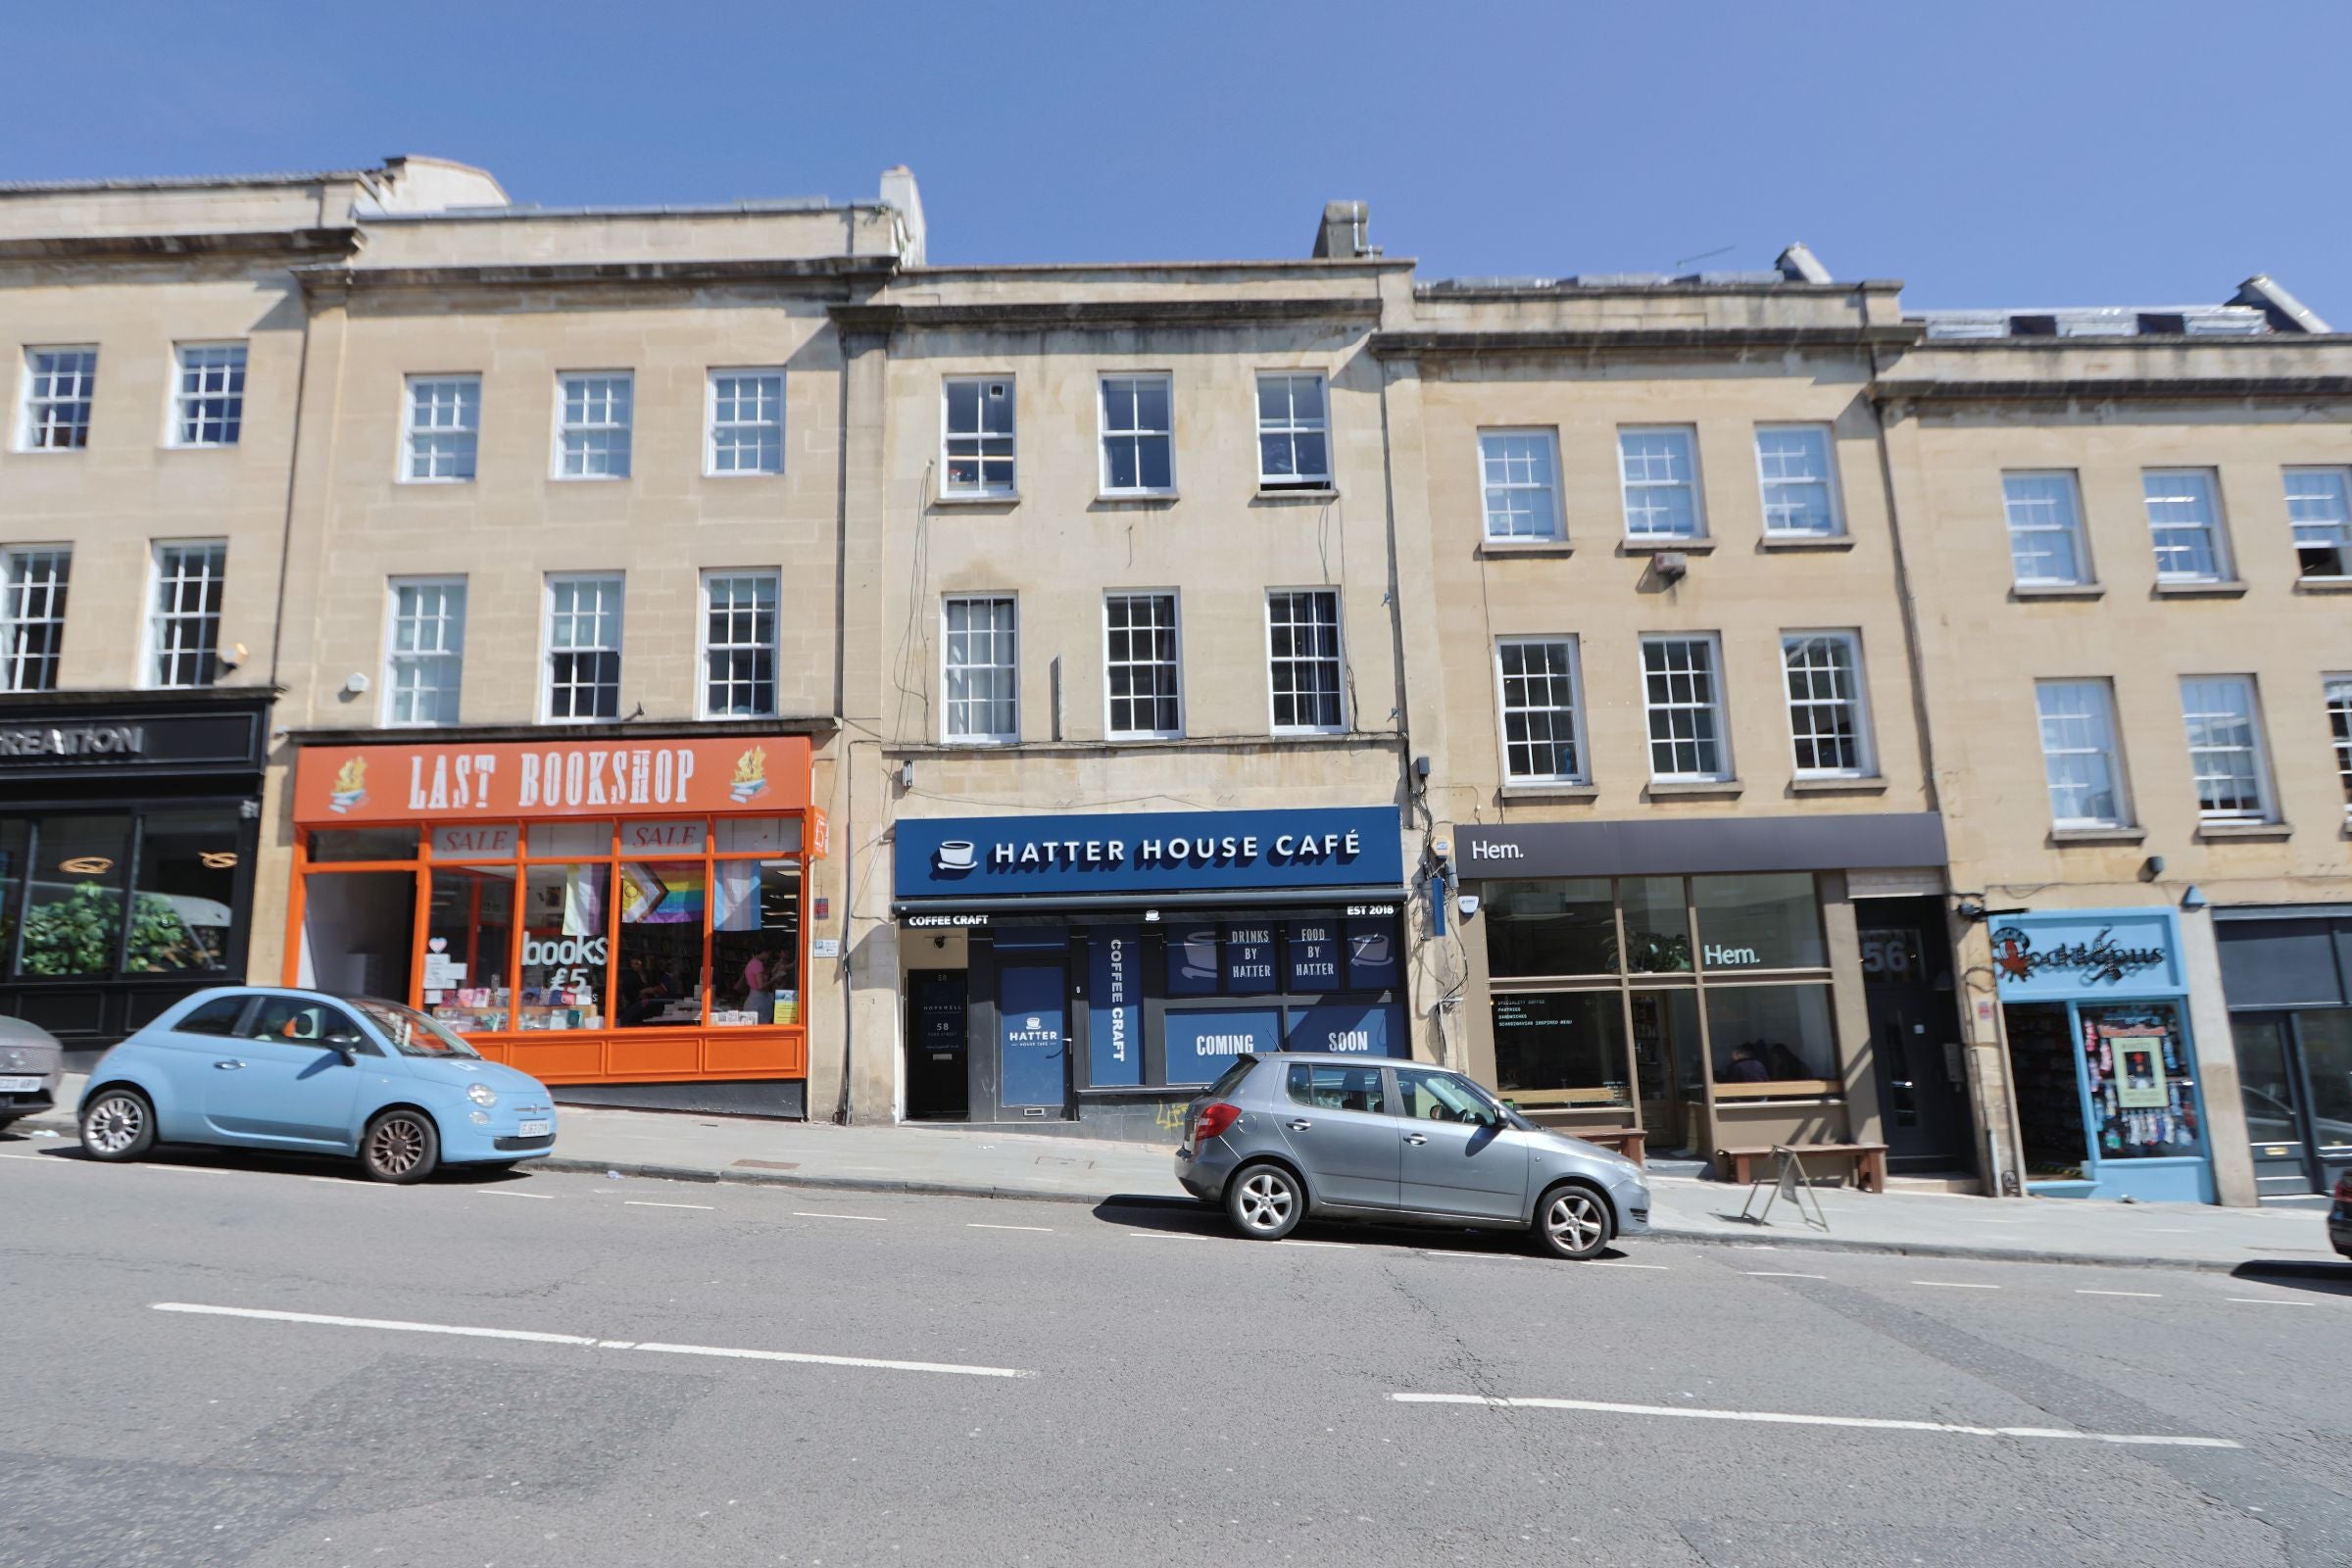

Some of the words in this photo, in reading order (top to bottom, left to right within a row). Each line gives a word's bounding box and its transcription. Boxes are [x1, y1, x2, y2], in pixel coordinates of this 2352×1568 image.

[408, 754, 496, 810] LAST
[517, 749, 695, 808] BOOKSHOP
[442, 830, 509, 854] SALE
[632, 825, 697, 848] SALE
[995, 839, 1125, 863] HATTER
[1143, 837, 1258, 860] HOUSE
[1275, 829, 1360, 857] CAFÉ
[1471, 840, 1524, 859] Hem.
[908, 915, 952, 926] COFFEE
[953, 914, 989, 925] CRAFT
[1347, 905, 1367, 916] EST
[1369, 905, 1395, 915] 2018
[1232, 929, 1269, 943] DRINKS
[1301, 928, 1325, 941] FOOD
[521, 931, 609, 966] books
[1245, 948, 1257, 960] BY
[1307, 946, 1320, 958] BY
[1703, 944, 1761, 965] Hem.
[1863, 941, 1908, 973] 56
[1110, 939, 1123, 1004] COFFEE
[1233, 965, 1271, 978] HATTER
[1296, 963, 1334, 976] HATTER
[550, 967, 589, 995] £5
[936, 1022, 950, 1031] 58
[1009, 1031, 1057, 1042] HATTER
[1112, 1006, 1125, 1062] CRAFT
[1196, 1034, 1254, 1056] COMING
[1328, 1031, 1369, 1053] SOON
